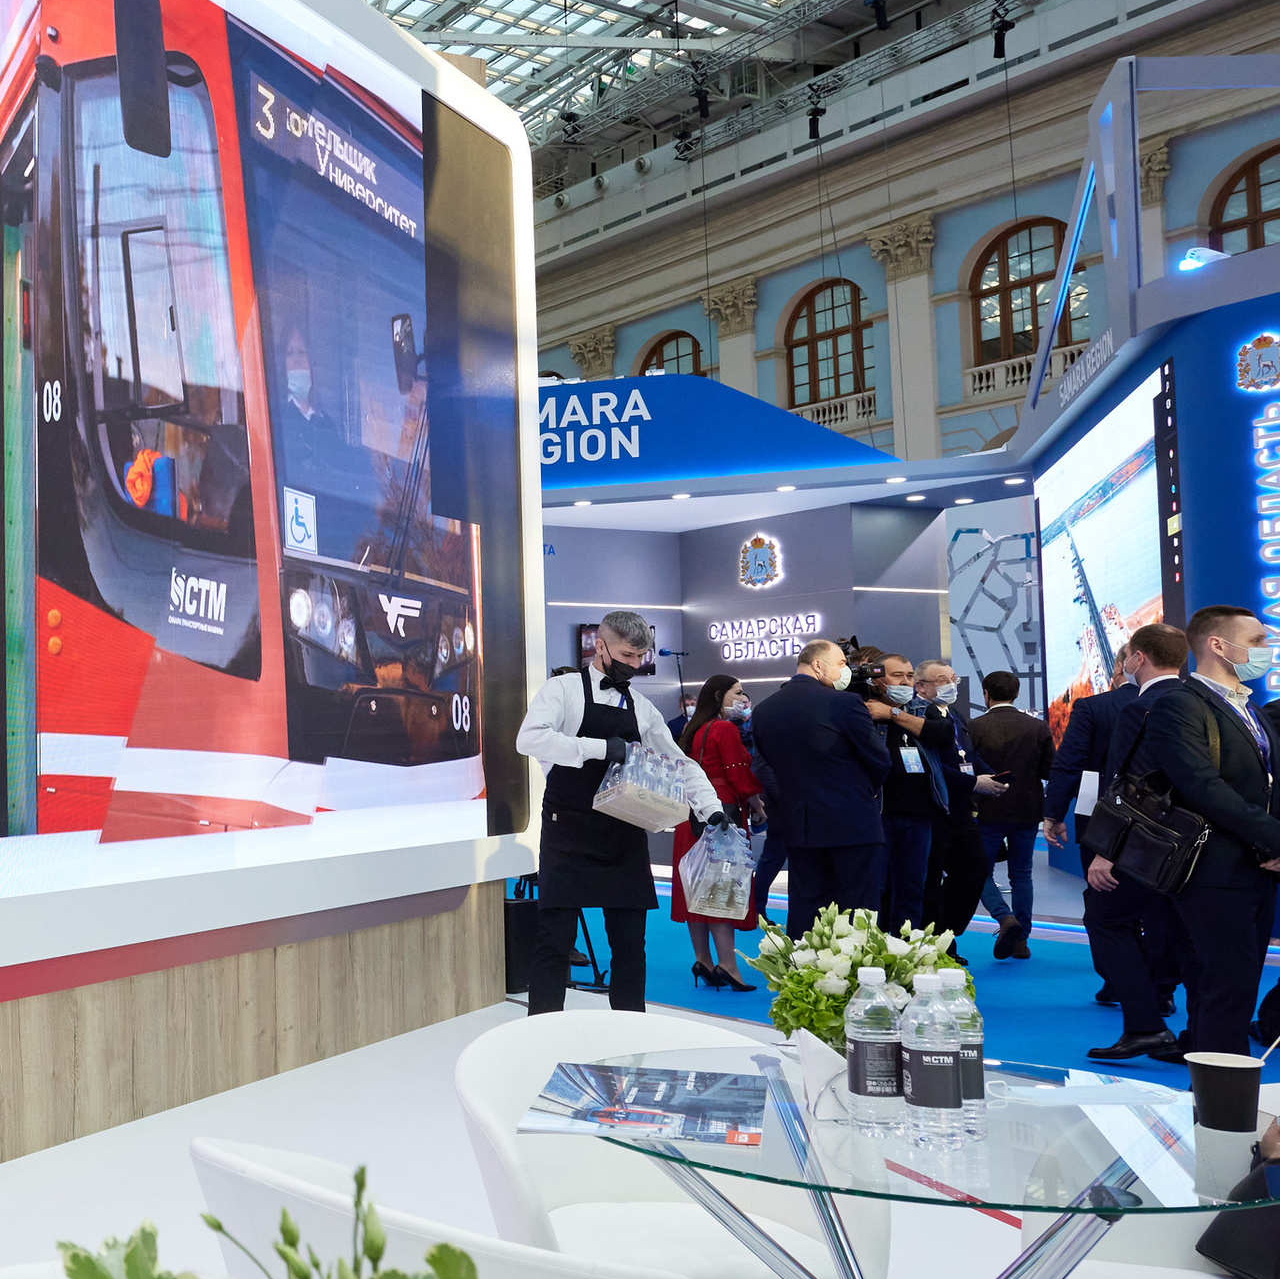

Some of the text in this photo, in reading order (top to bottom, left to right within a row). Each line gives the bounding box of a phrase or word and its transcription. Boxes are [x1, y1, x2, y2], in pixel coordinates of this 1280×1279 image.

[255, 83, 275, 140] 3
[1059, 326, 1114, 408] SAMARA REGION
[43, 380, 62, 422] 08
[184, 576, 227, 623] СТМ
[708, 614, 817, 640] САМАРСКАЯ
[721, 637, 802, 660] ОБЛАСТЬ
[452, 693, 471, 733] 08
[931, 1055, 954, 1064] СТМ
